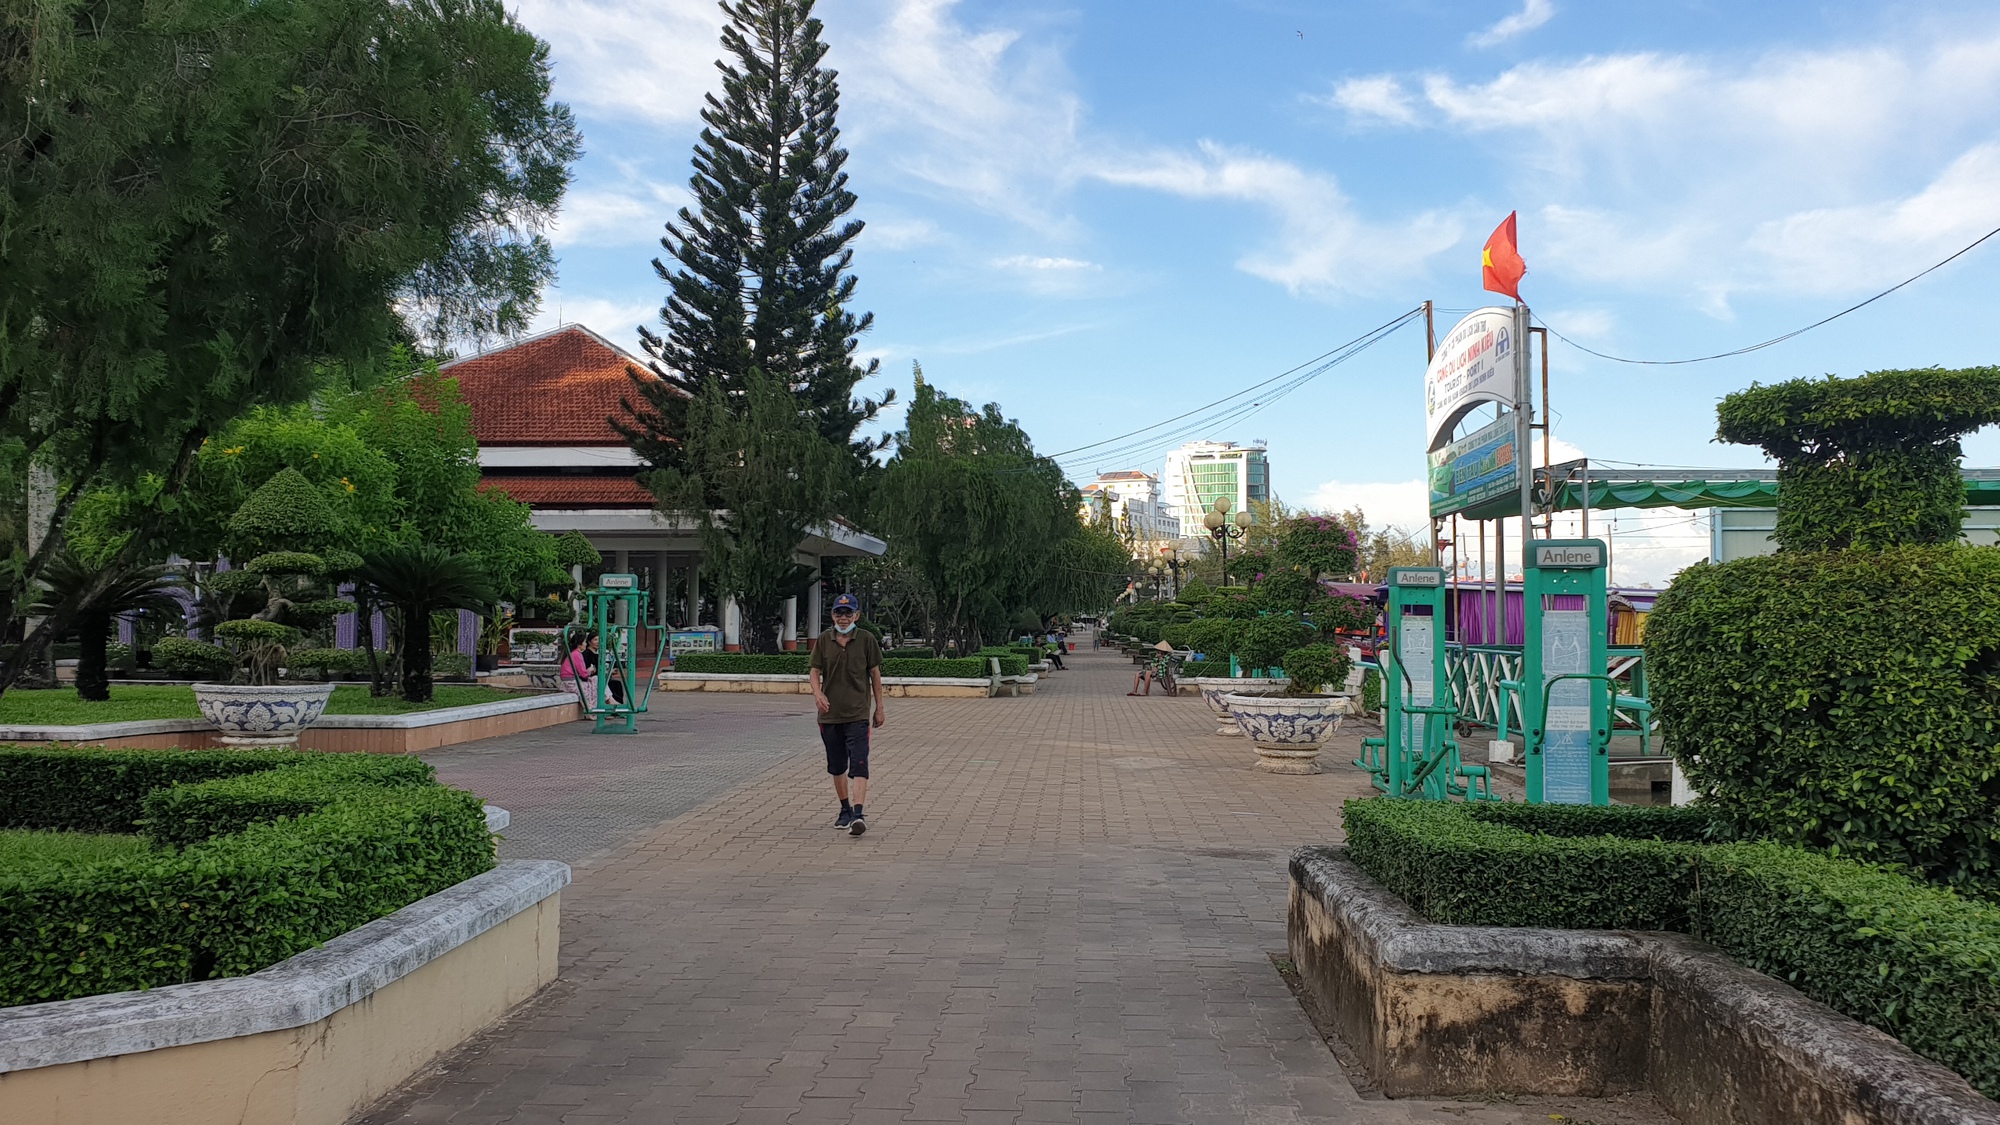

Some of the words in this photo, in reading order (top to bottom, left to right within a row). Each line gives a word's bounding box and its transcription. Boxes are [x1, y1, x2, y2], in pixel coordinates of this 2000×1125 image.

[1444, 374, 1462, 394] TOURIST
[1466, 361, 1480, 380] PORT
[1542, 549, 1592, 563] Anlene
[1401, 573, 1435, 583] Anlene
